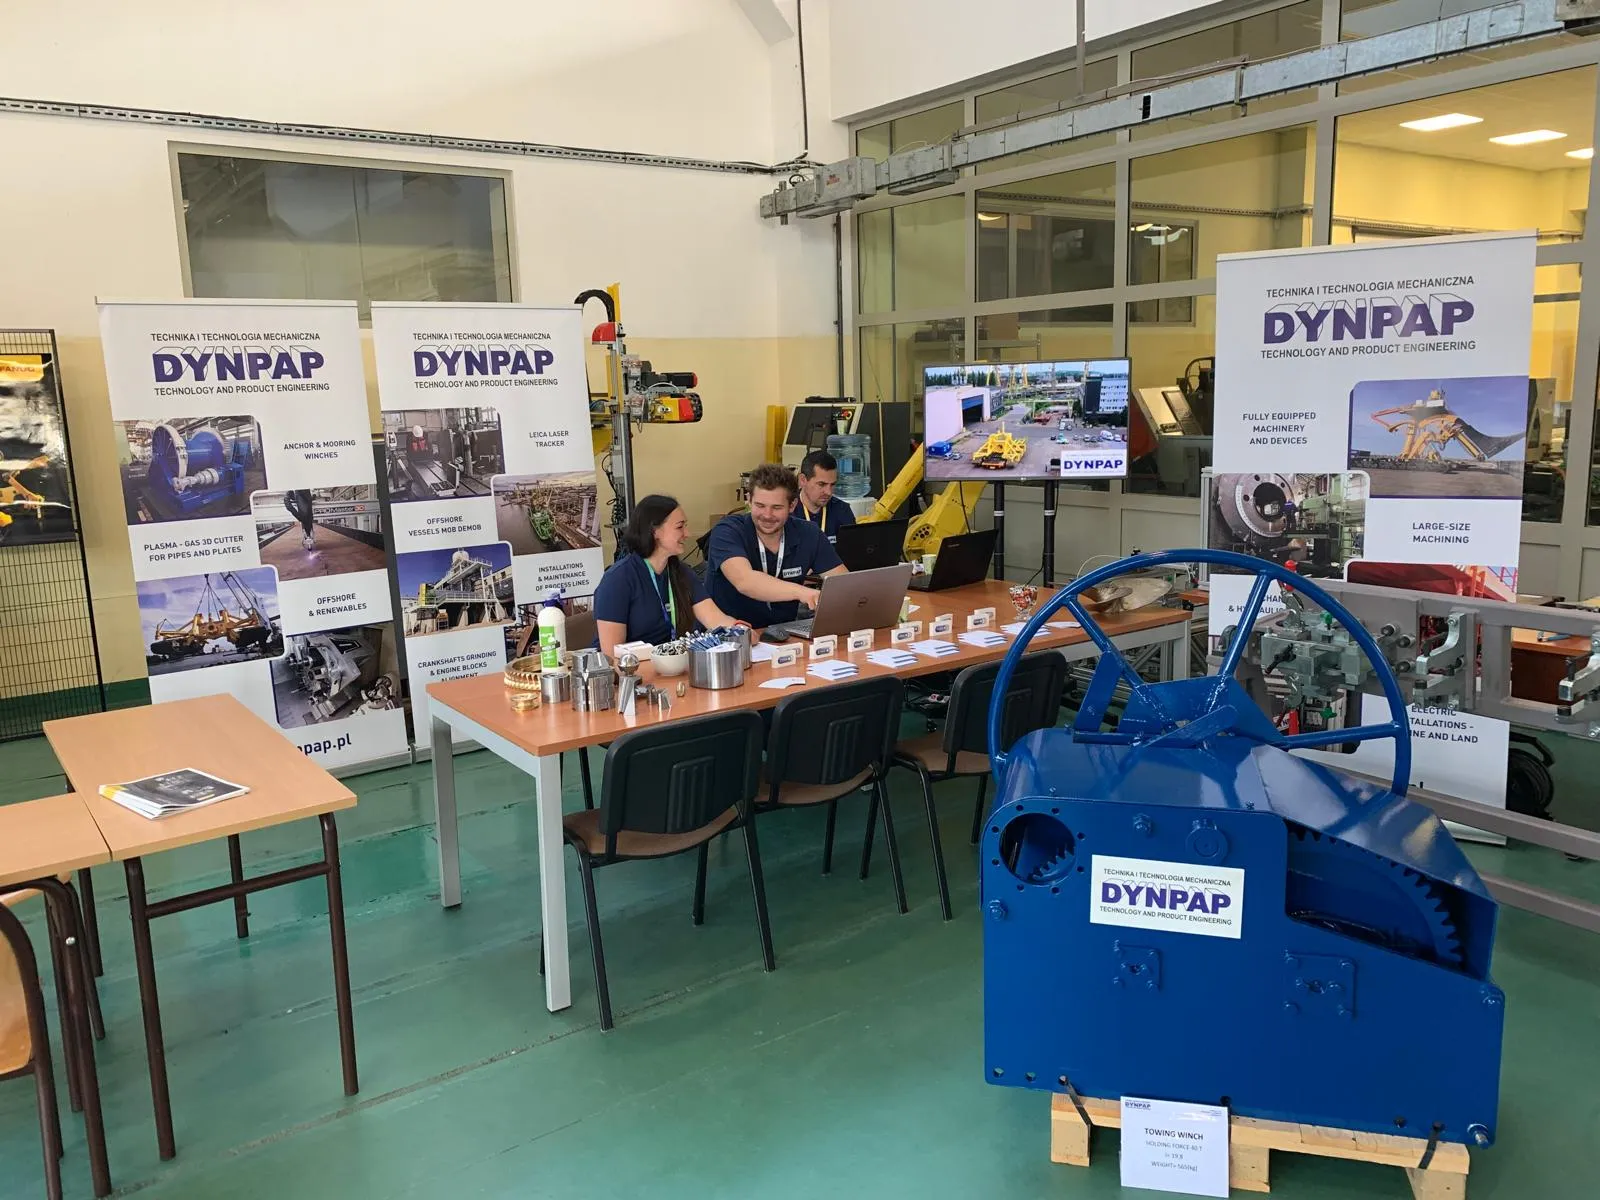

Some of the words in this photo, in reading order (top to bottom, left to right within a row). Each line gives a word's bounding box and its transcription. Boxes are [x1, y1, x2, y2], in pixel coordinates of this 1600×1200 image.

[1266, 286, 1315, 298] TECHNIKA
[1322, 281, 1394, 295] TECHNOLOGIA
[1397, 275, 1474, 289] MECHANICZNA
[1263, 293, 1475, 344] DYNPAP
[150, 333, 195, 342] TECHNIKA
[202, 334, 262, 342] TECHNOLOGIA
[263, 333, 321, 341] MECHANICZNA
[413, 332, 450, 340] TECHNIKA
[504, 332, 551, 340] MECHANICZNA
[1261, 347, 1326, 359] TECHNOLOGY
[1328, 346, 1349, 356] AND
[1352, 344, 1400, 355] PRODUCT
[1403, 340, 1476, 353] ENGINEERING
[152, 345, 325, 383] DYNPAP
[413, 344, 554, 377] DYNPAP
[154, 386, 214, 396] TECHNOLOGY
[216, 386, 234, 394] AND
[236, 384, 275, 393] PRODUCT
[276, 383, 330, 392] ENGINEERING
[415, 381, 464, 389] TECHNOLOGY
[1242, 412, 1270, 421] FULLY
[1271, 411, 1316, 421] EQUIPPED
[1252, 424, 1305, 433] MACHINERY
[529, 431, 548, 439] LEICA
[549, 430, 570, 438] LASER
[284, 441, 314, 450] ANCHOR
[322, 440, 356, 448] MOORING
[535, 440, 565, 448] TRACKER
[1249, 436, 1268, 445] AND
[1270, 436, 1308, 445] DEVICES
[304, 452, 338, 460] WINCHES
[1063, 459, 1124, 471] DYNPAP
[426, 516, 463, 525] OFFSHORE
[408, 527, 440, 537] VESSELS
[441, 526, 457, 534] MOB
[458, 525, 482, 533] DEMOB
[1412, 522, 1471, 532] LARGE-SIZE
[144, 541, 178, 551] PLASMA
[184, 539, 200, 548] GAS
[202, 537, 212, 546] 3D
[213, 535, 244, 545] CUTTER
[1412, 534, 1470, 544] MACHINING
[149, 553, 166, 562] FOR
[168, 550, 192, 560] PIPES
[193, 548, 211, 557] AND
[212, 546, 242, 556] PLATES
[538, 563, 584, 573] INSTALLATIONS
[544, 571, 586, 581] MAINTENANCE
[316, 593, 356, 605] OFFSHORE
[316, 603, 367, 616] RENEWABLES
[1228, 605, 1234, 614] &
[418, 656, 465, 668] CRANKSHAFTS
[466, 651, 496, 660] GRINDING
[436, 666, 461, 675] ENGINE
[462, 662, 487, 671] BLOCKS
[1412, 706, 1456, 716] ELECTRIC
[1410, 718, 1467, 729] TALLATIONS
[1428, 732, 1449, 740] AND
[1451, 734, 1478, 743] LAND
[1104, 868, 1134, 877] TECHNIKA
[1139, 872, 1184, 882] TECHNOLOGIA
[1185, 876, 1231, 886] MECHANICZNA
[1102, 878, 1231, 915] DYNPAP
[1100, 905, 1142, 915] TECHNOLOGY
[1157, 912, 1187, 921] PRODUCT
[1188, 915, 1232, 926] ENGINEERING
[1144, 1128, 1176, 1137] TOWING
[1177, 1131, 1204, 1140] WINCH
